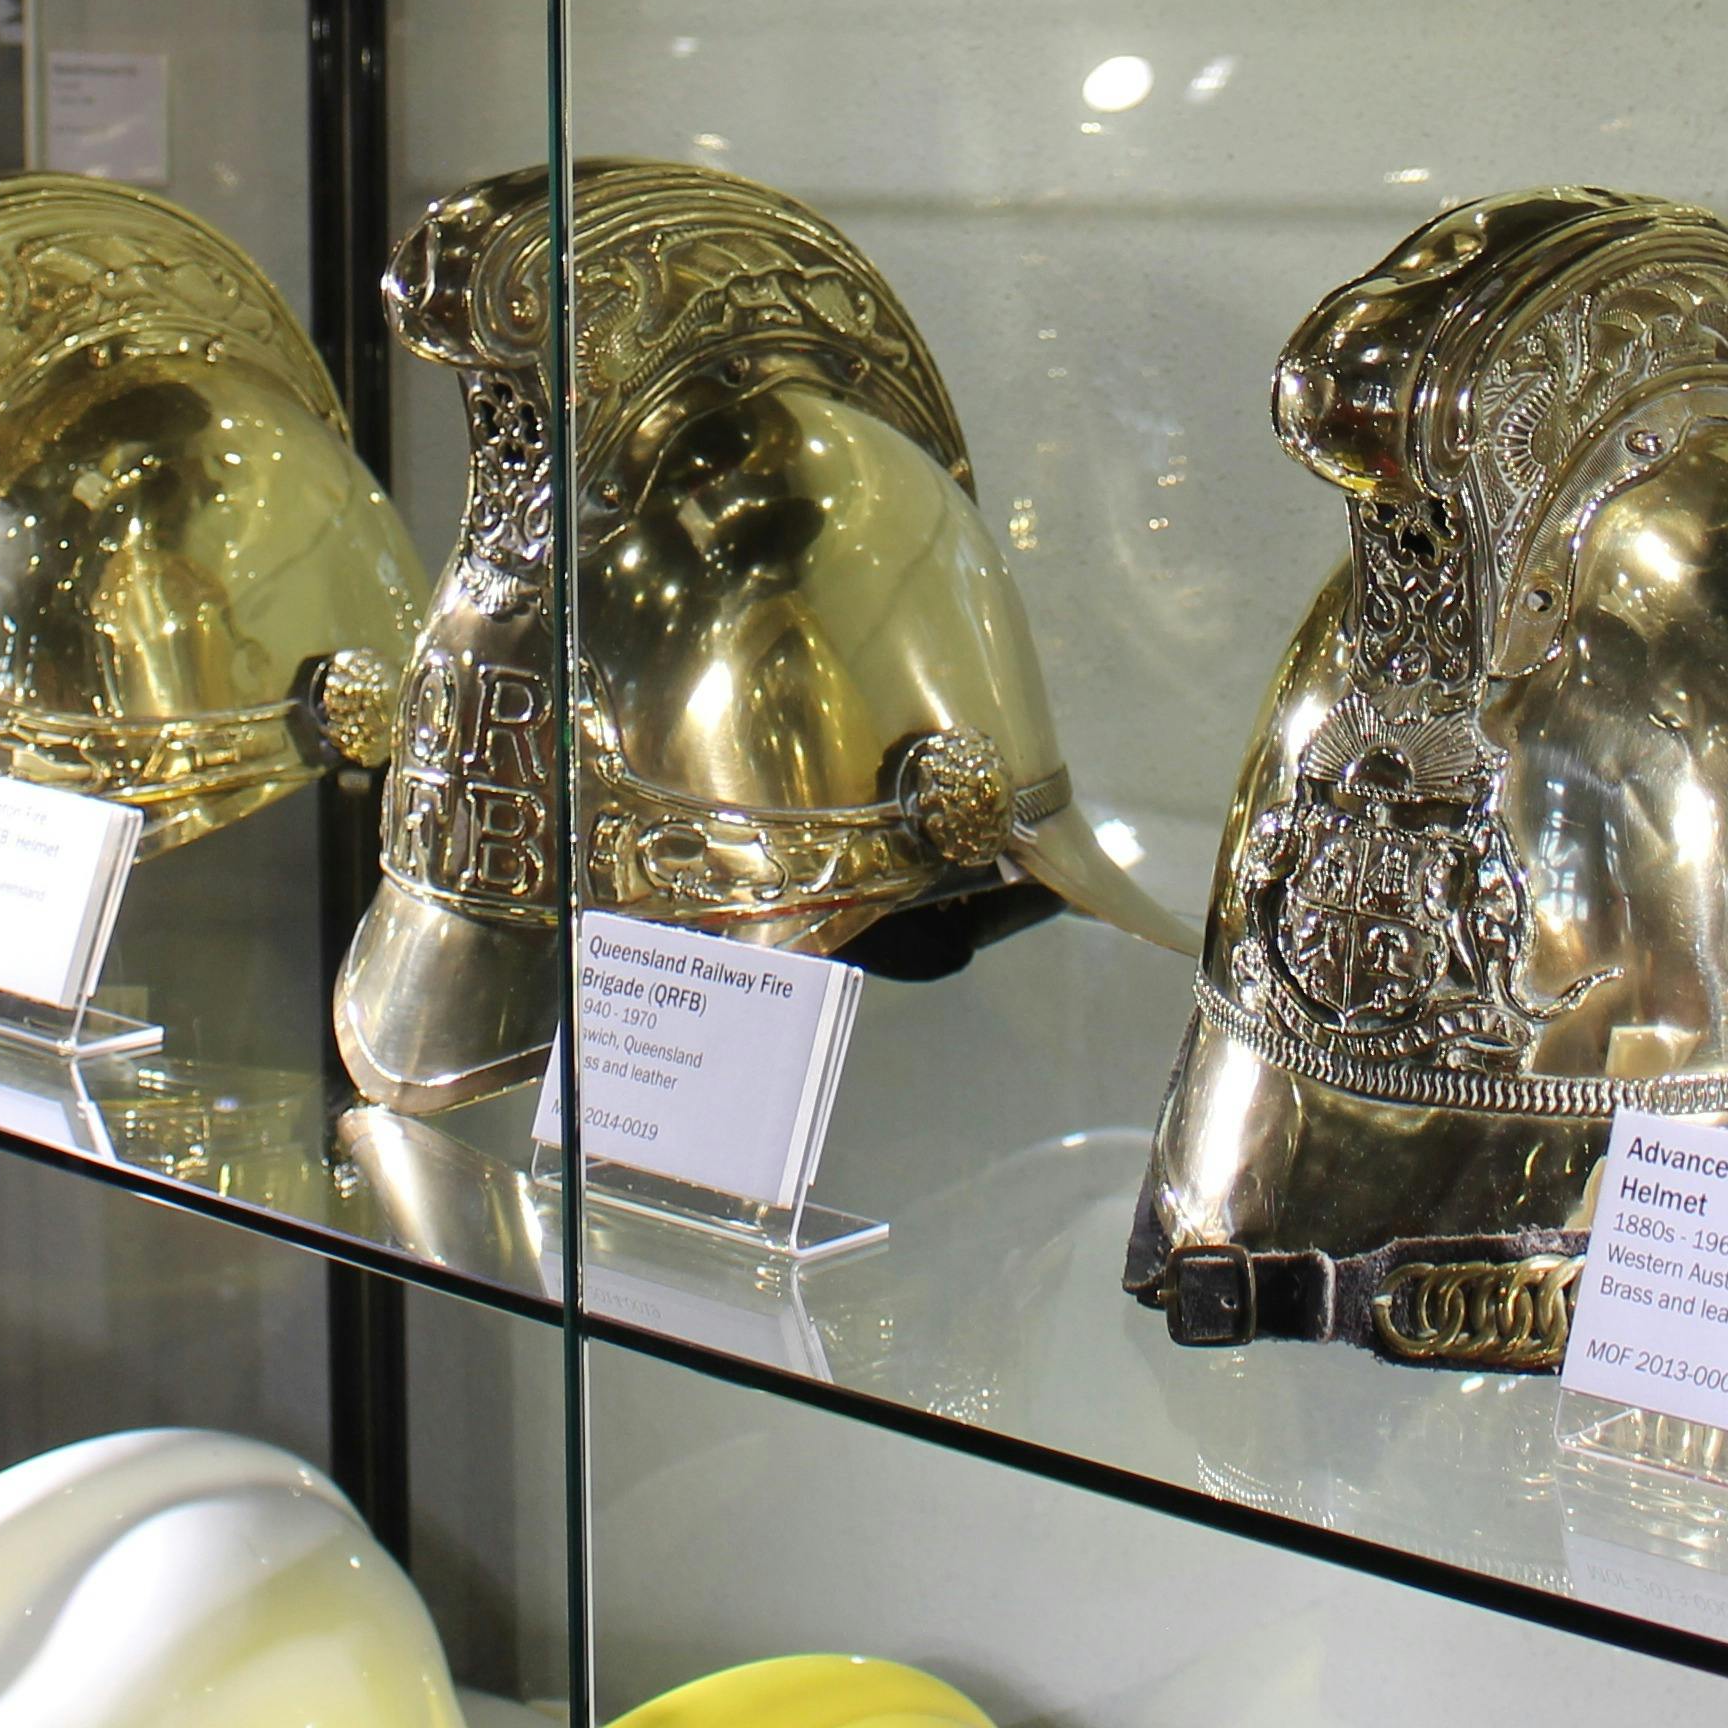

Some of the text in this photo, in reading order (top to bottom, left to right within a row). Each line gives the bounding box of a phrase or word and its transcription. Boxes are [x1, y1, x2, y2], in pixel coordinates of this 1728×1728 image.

[589, 935, 793, 998] Queensland Railway Fire
[581, 966, 708, 1017] Brigade (QRFB)
[583, 998, 612, 1019] 940
[623, 1007, 657, 1030] 1970
[582, 1027, 620, 1050] wich,
[623, 1034, 704, 1069] Queensland
[602, 1058, 628, 1079] and
[630, 1065, 678, 1092] leather
[584, 1106, 659, 1142] 2014-0019
[1620, 1174, 1708, 1217] Helmet
[1613, 1211, 1675, 1244] 1880s
[1607, 1242, 1683, 1278] Western
[1600, 1275, 1653, 1305] Brass
[1658, 1289, 1695, 1316] and
[1586, 1338, 1634, 1368] MOF
